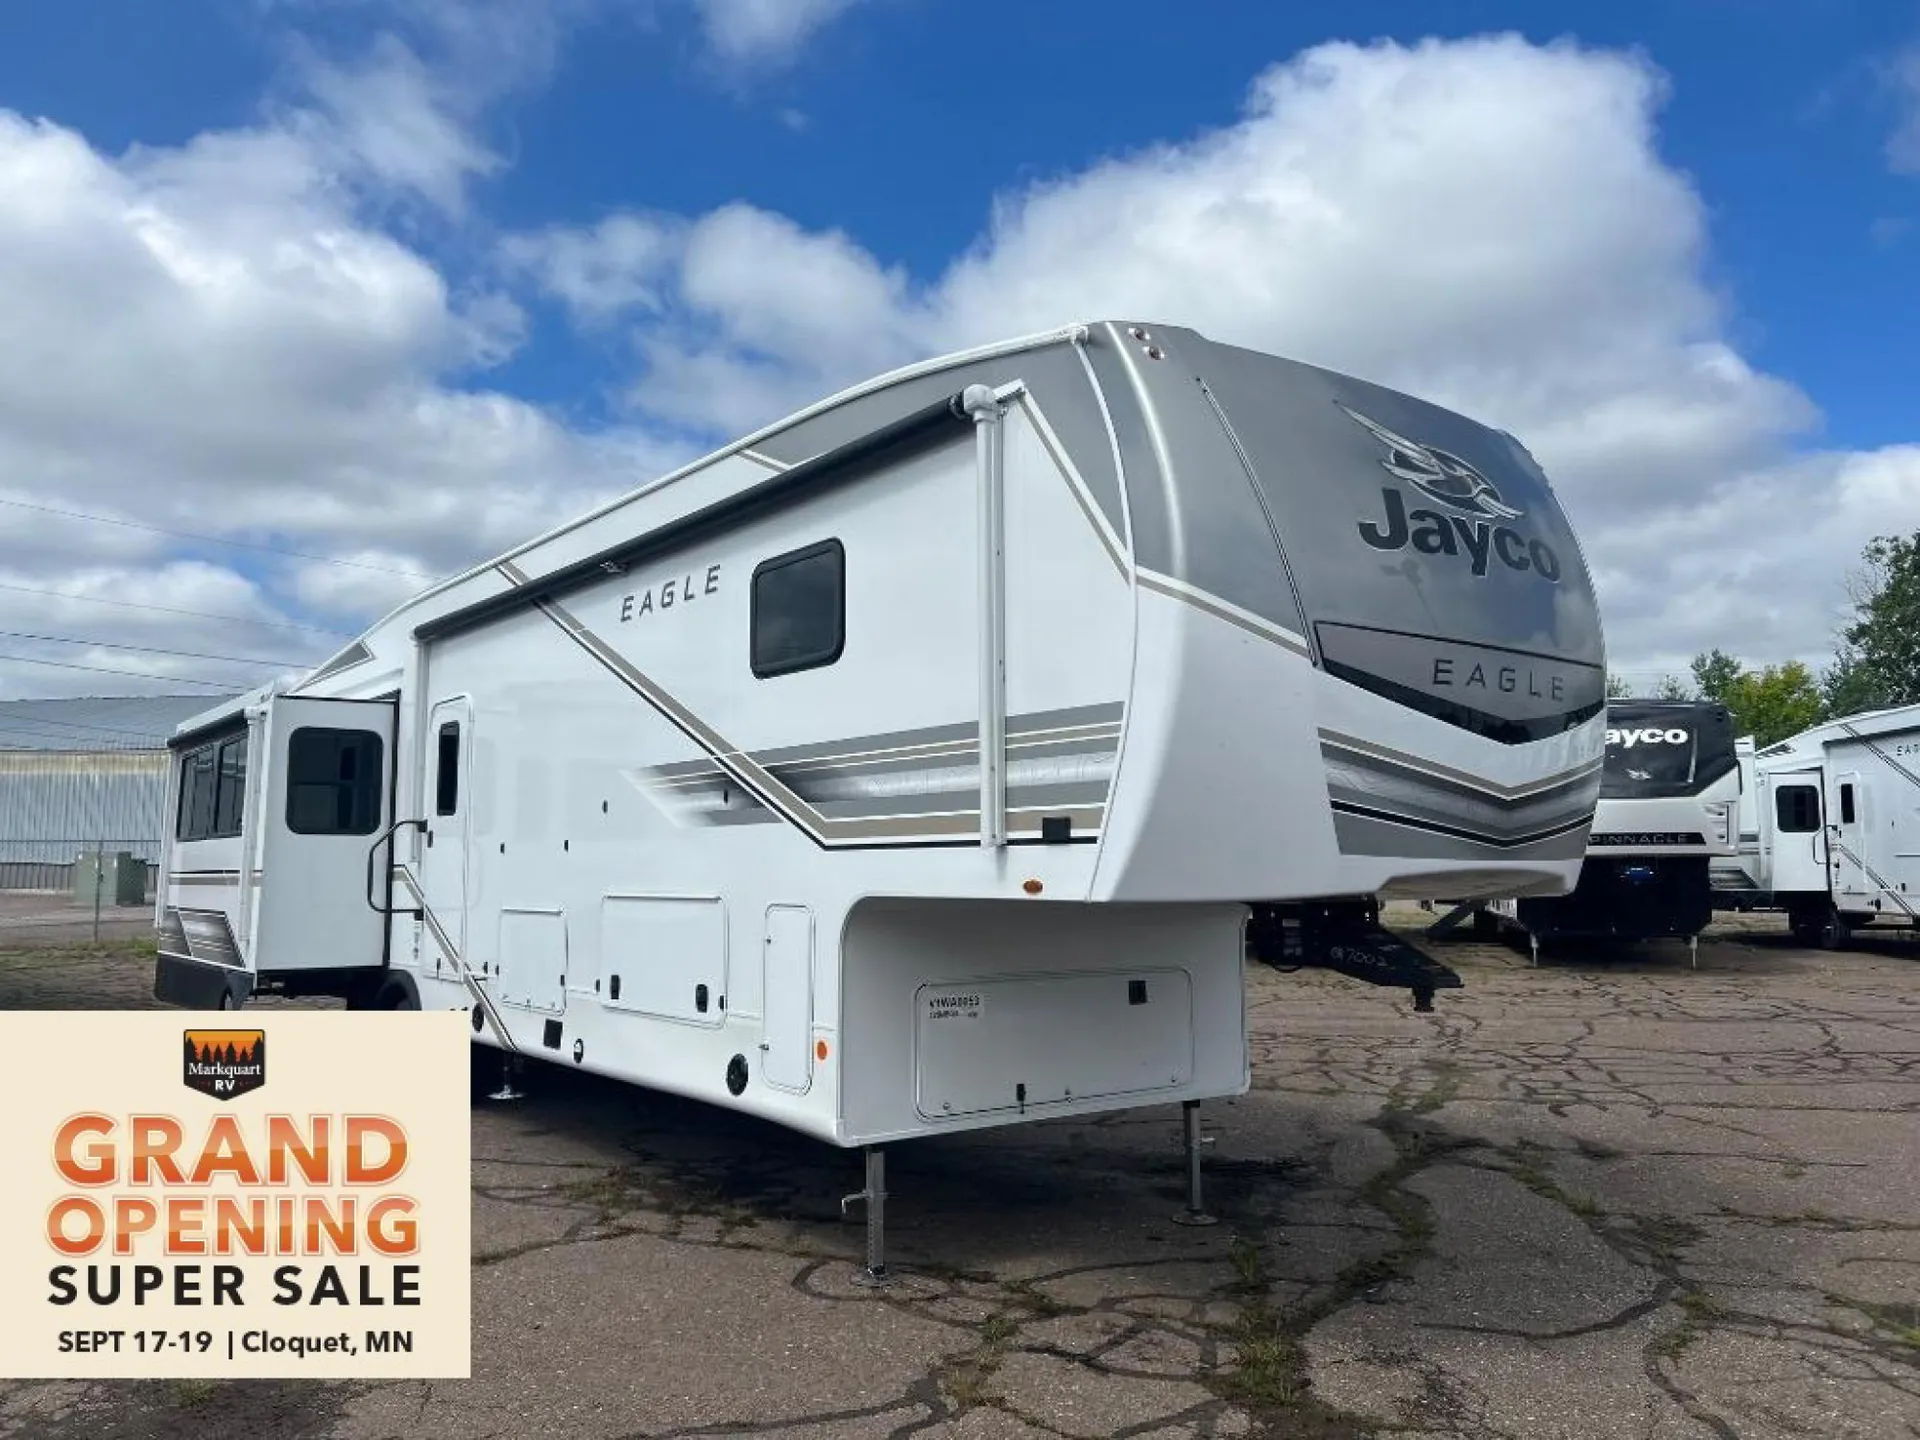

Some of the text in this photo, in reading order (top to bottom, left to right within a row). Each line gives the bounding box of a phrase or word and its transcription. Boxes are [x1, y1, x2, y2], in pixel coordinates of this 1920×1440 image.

[1357, 487, 1561, 583] Jayco
[620, 563, 721, 623] EAGLE
[1432, 658, 1565, 701] EAGLE
[1604, 728, 1689, 749] ayco
[1589, 833, 1688, 844] PINNACLE
